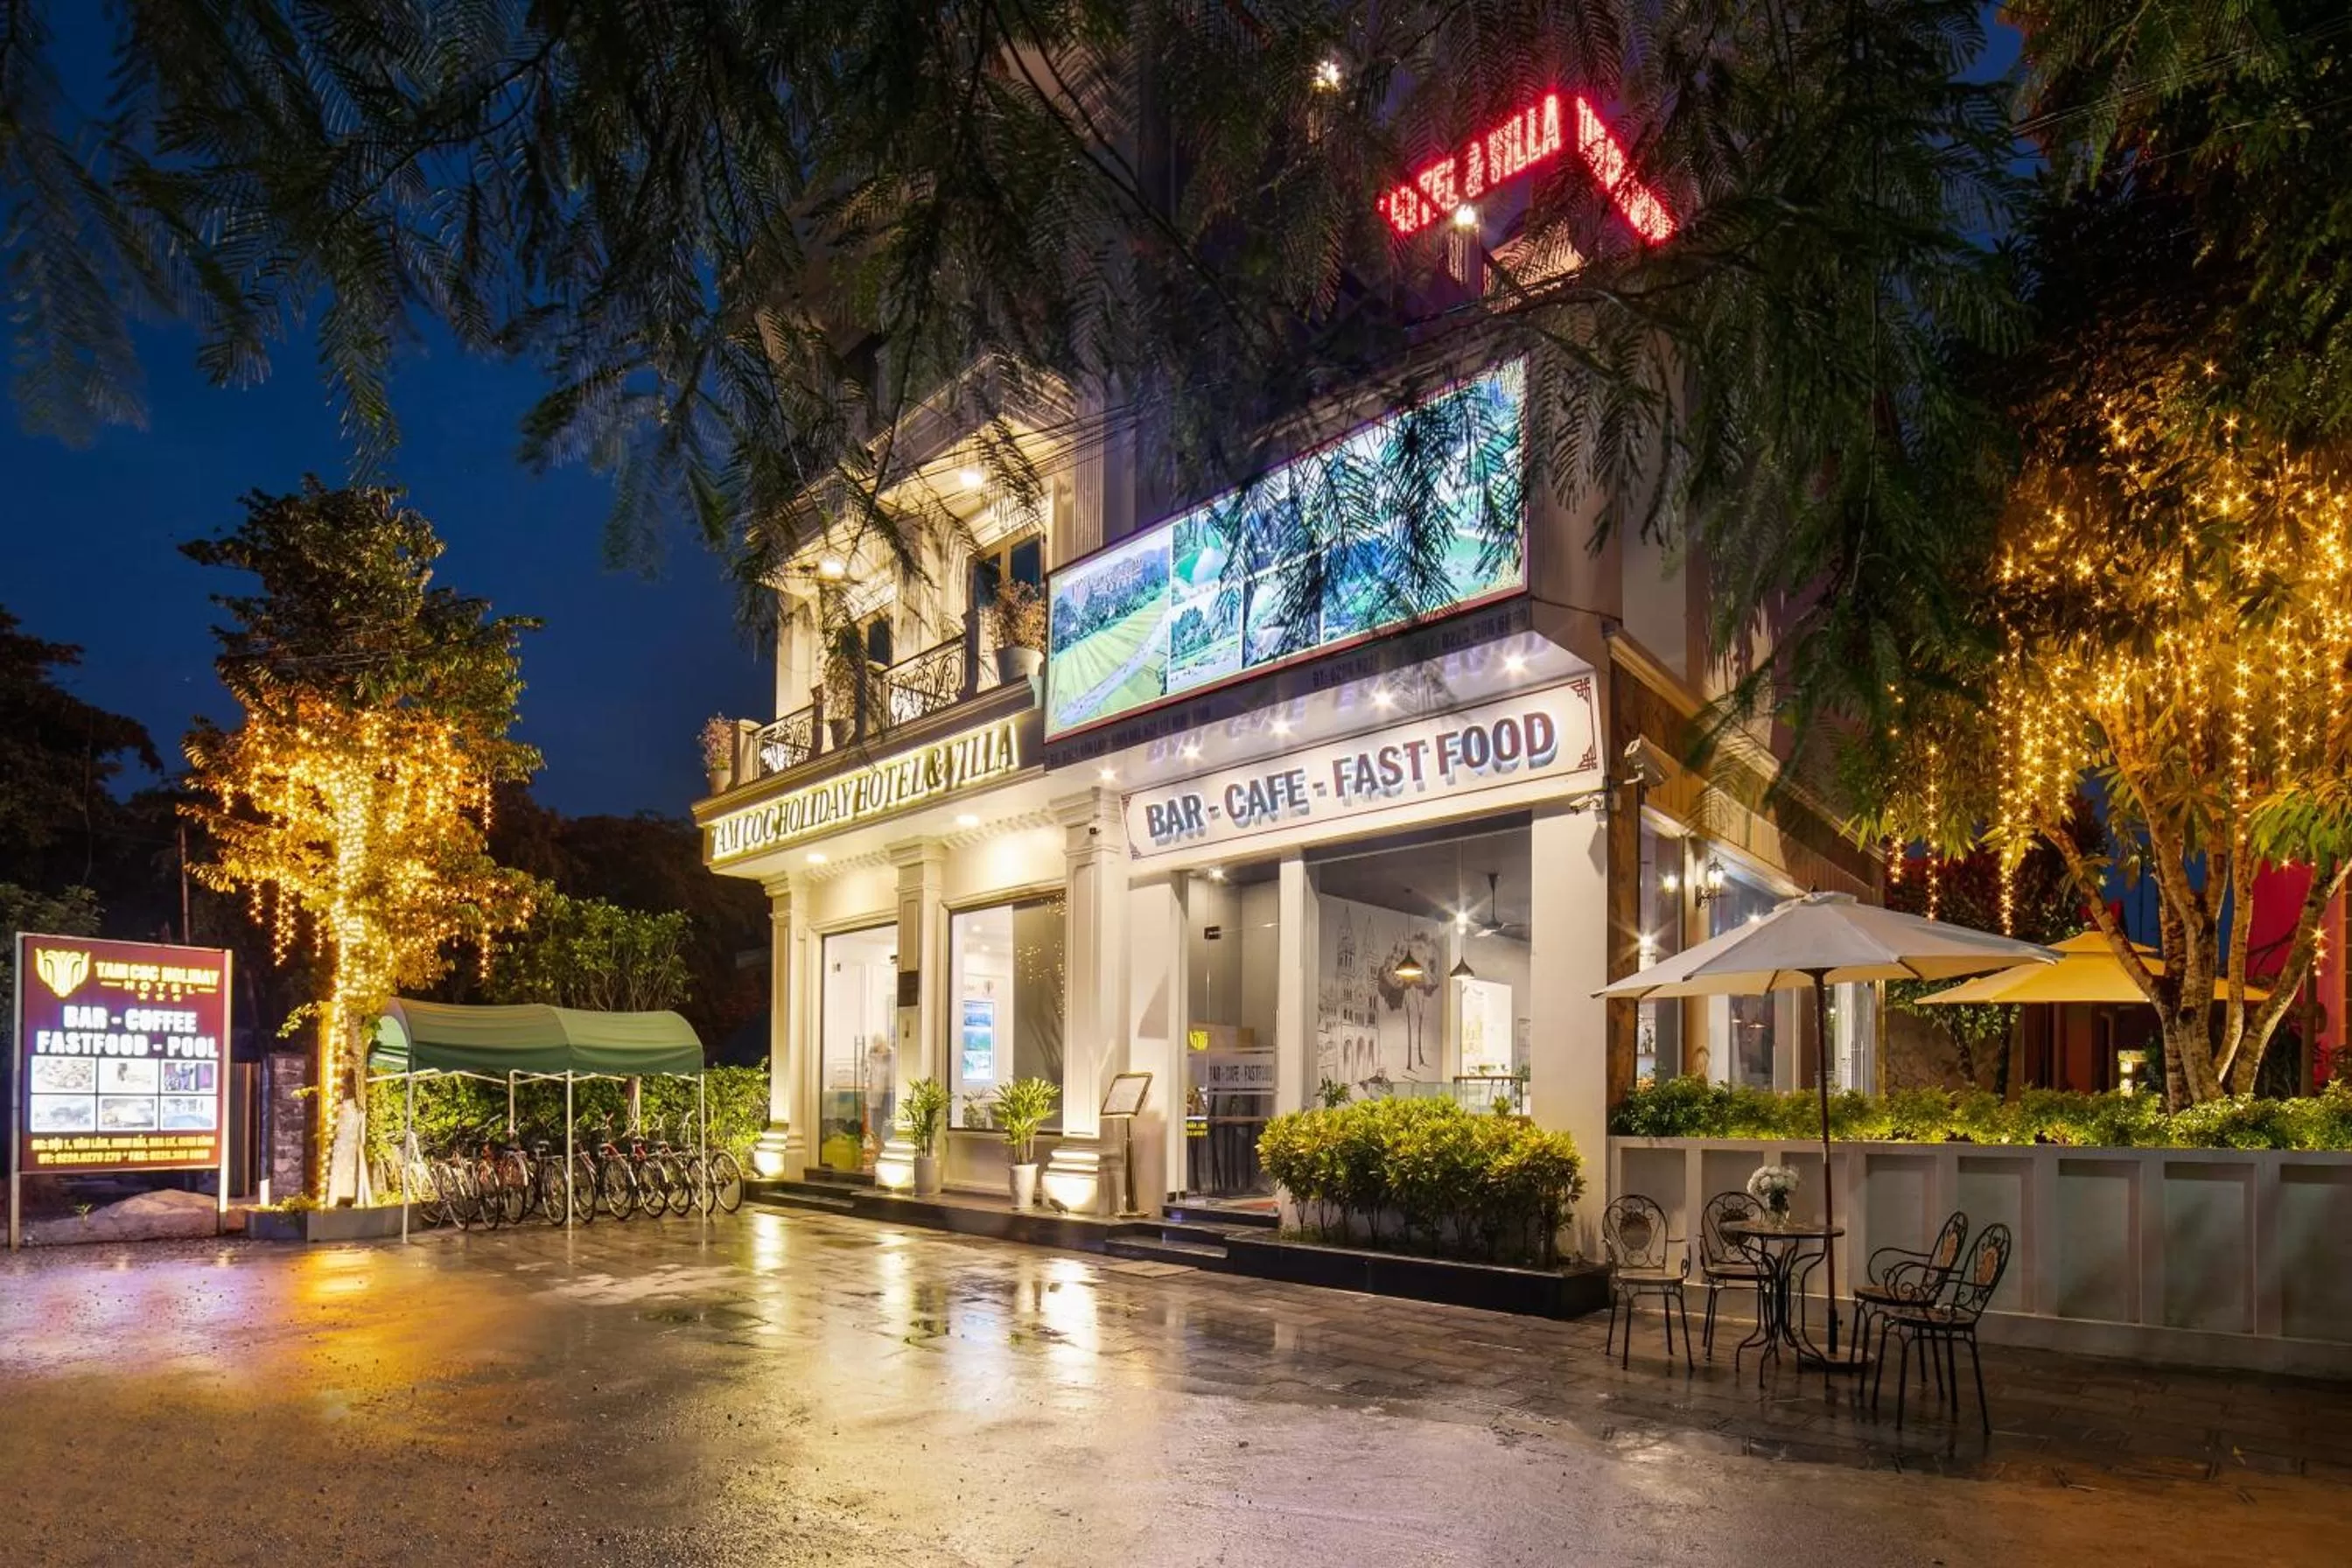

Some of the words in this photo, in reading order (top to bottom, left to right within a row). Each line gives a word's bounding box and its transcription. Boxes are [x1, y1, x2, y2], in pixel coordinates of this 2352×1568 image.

[1488, 94, 1560, 184] VILLA
[743, 807, 776, 847] COC
[777, 779, 855, 837] HOLIDAY
[856, 755, 928, 813] HOTEL
[927, 748, 945, 790] &
[947, 724, 1018, 789] VILLA
[1145, 794, 1206, 840] BAR
[1225, 766, 1310, 822] CAFE
[1333, 739, 1427, 798] FAST
[1436, 711, 1557, 777] FOOD
[123, 980, 195, 995] HOTEL
[36, 1030, 149, 1056] FASTFOOD
[166, 1035, 219, 1058] POOL
[63, 1005, 108, 1029] BAR
[124, 1008, 198, 1032] COFFEE
